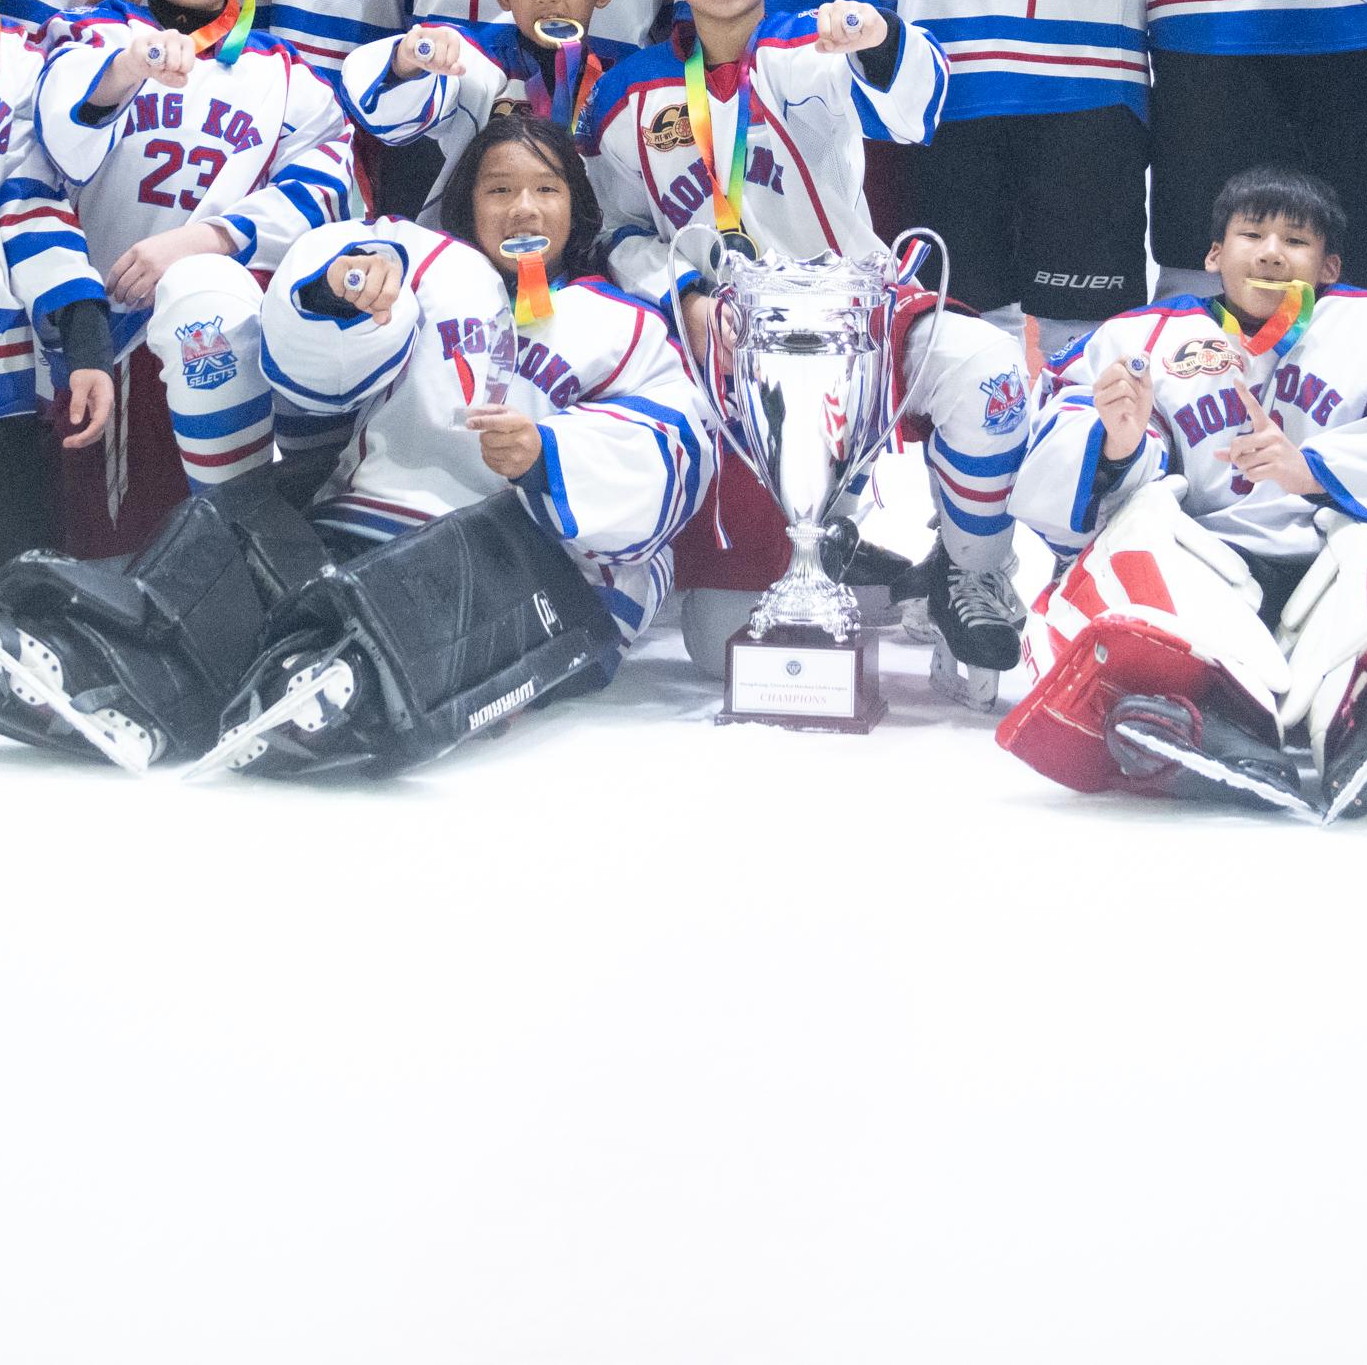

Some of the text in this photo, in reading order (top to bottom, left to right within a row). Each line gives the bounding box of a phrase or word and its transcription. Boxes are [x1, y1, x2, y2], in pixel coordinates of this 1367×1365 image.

[137, 138, 228, 211] 23
[1033, 269, 1126, 291] BAUER
[188, 369, 238, 387] SELECTS
[468, 679, 535, 732] WARRIOR
[759, 692, 828, 705] CHAMPIONS
